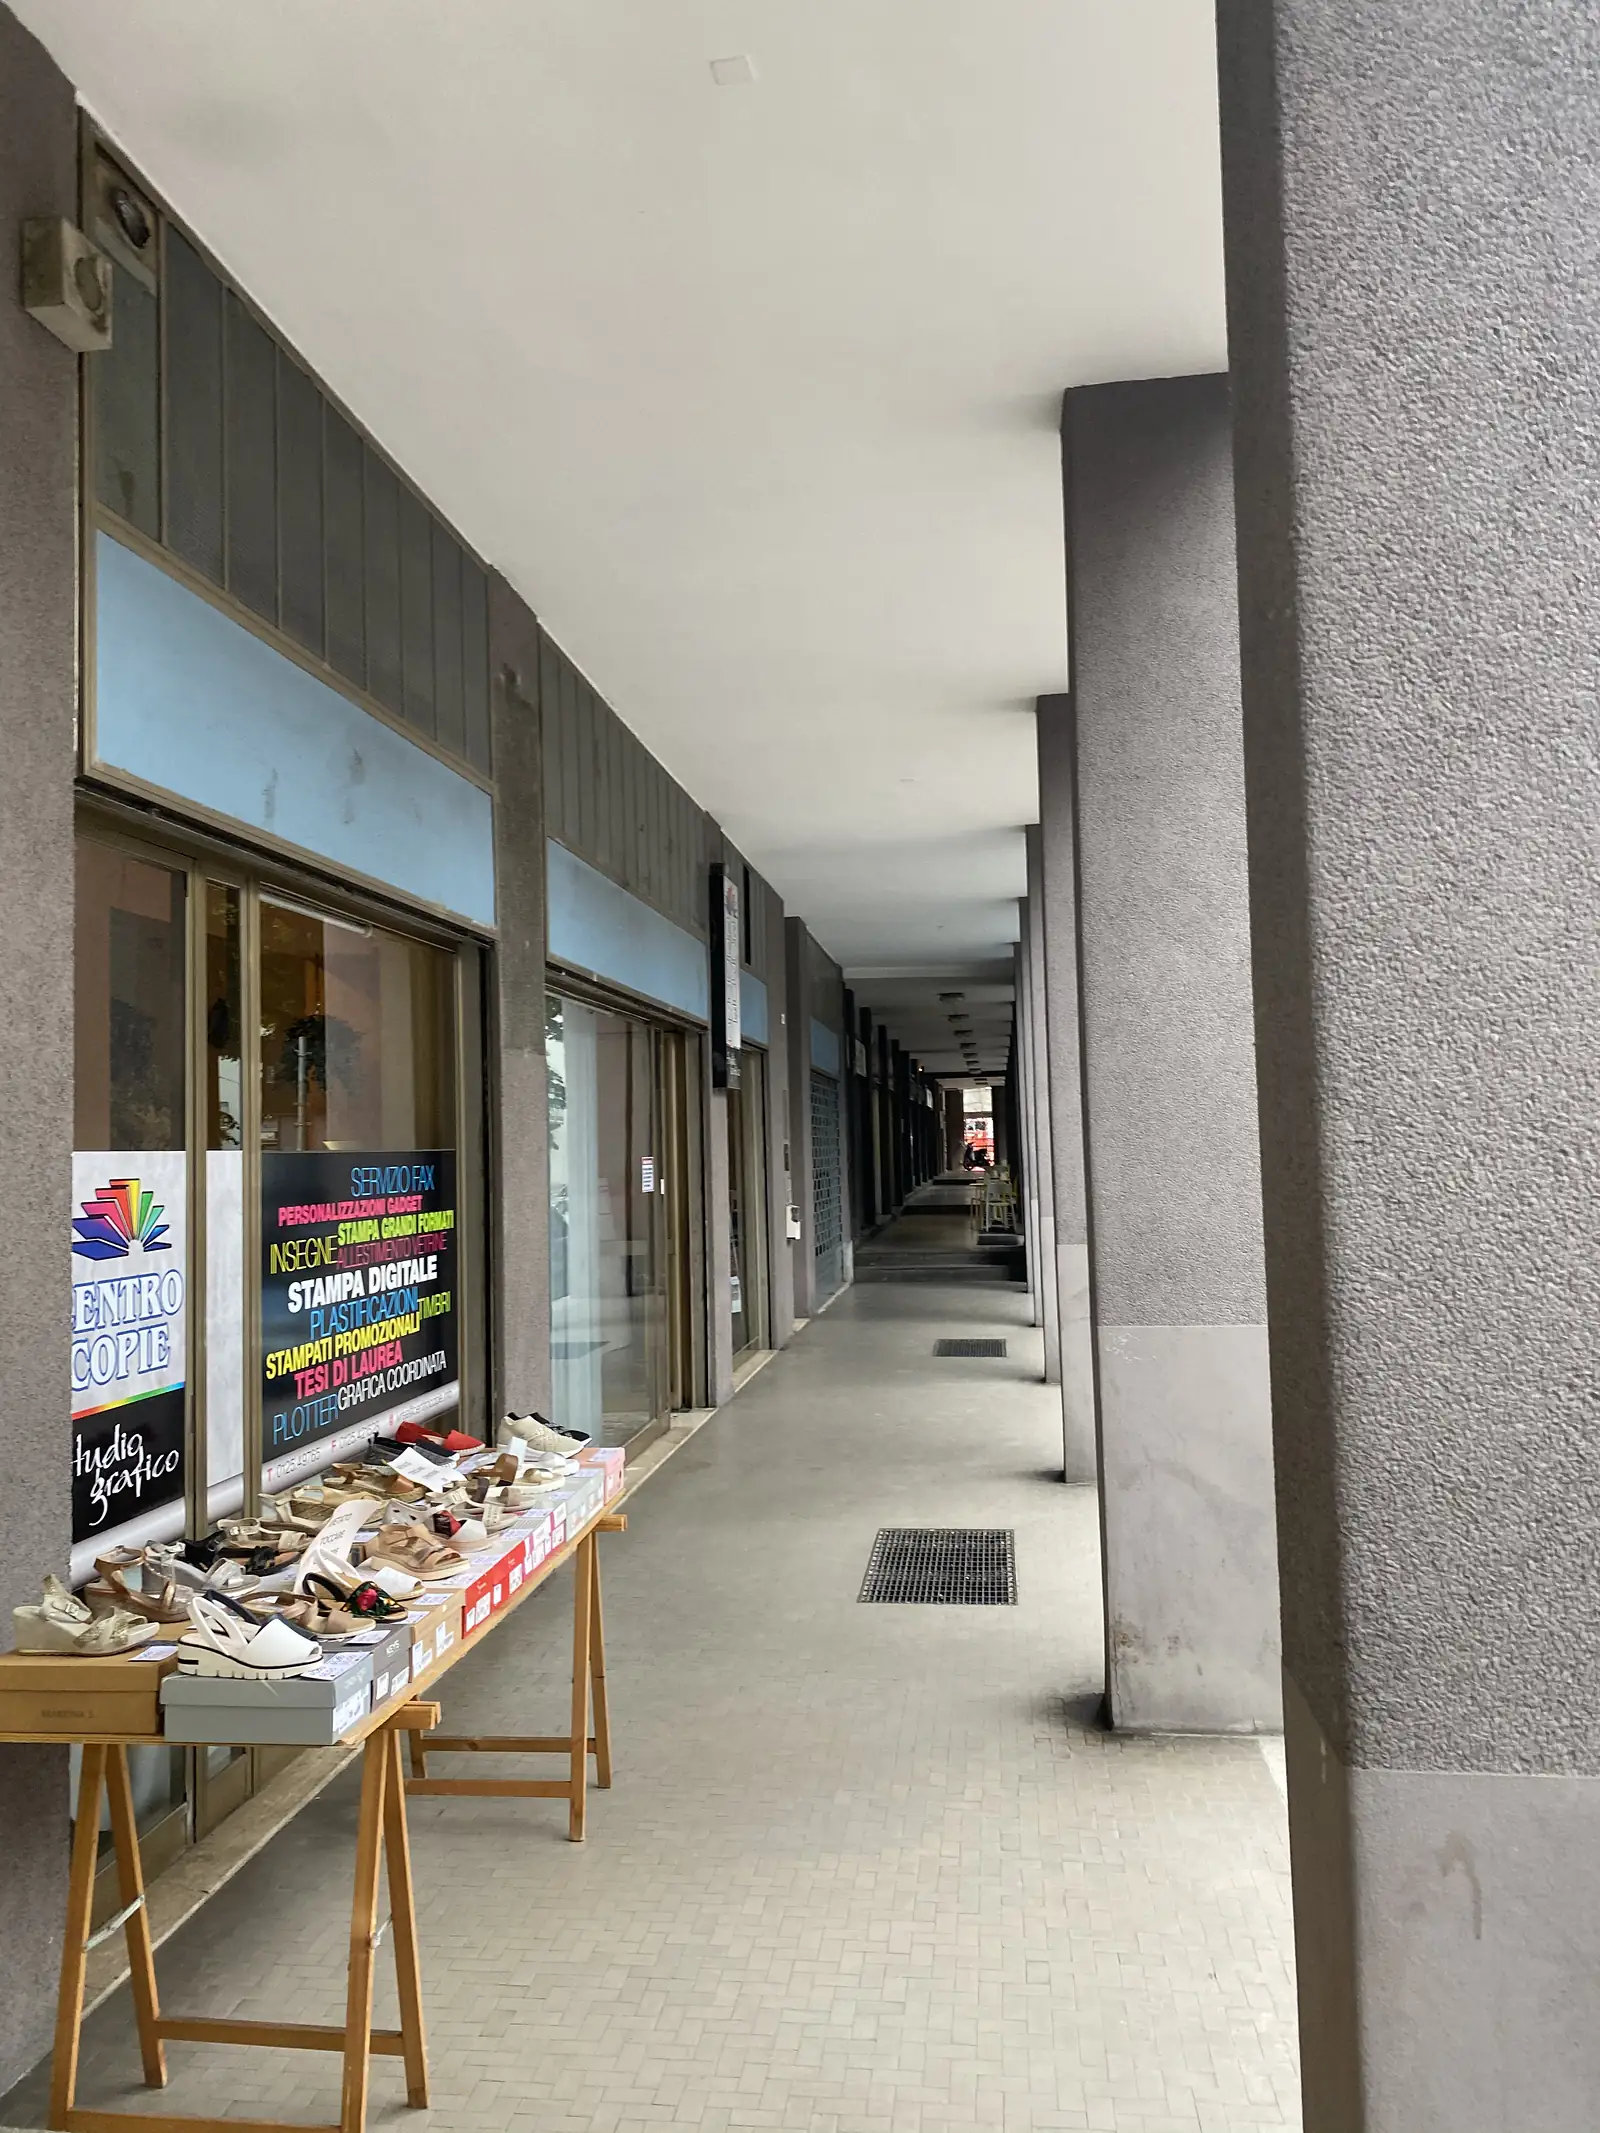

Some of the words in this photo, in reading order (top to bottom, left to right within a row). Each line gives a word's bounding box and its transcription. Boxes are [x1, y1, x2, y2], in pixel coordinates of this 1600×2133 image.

[351, 1165, 411, 1197] SERVIZIO
[412, 1165, 435, 1192] FAX
[278, 1198, 385, 1226] PERSONALIZZAZIONI
[387, 1195, 423, 1214] GADGET
[337, 1218, 380, 1246] STAMPA
[381, 1214, 417, 1240] GRANDI
[418, 1210, 454, 1234] FORMATI
[270, 1235, 338, 1274] INSEGNE
[336, 1237, 412, 1270] ALLESTIMENTO
[412, 1231, 448, 1255] VETRINE
[71, 1268, 184, 1334] ENTRO
[287, 1269, 366, 1314] STAMPA
[369, 1254, 438, 1295] DIGITALE
[416, 1290, 451, 1321] TIMBRI
[309, 1286, 419, 1341] PLASTIFICAZIONI
[71, 1322, 171, 1392] COPIE
[265, 1338, 333, 1380] STAMPATI
[334, 1312, 421, 1358] PROMOZIONALI
[293, 1365, 329, 1400] TESI
[332, 1354, 348, 1387] DI
[351, 1340, 403, 1383] LAUREA
[337, 1374, 386, 1412] GRAFICA
[386, 1350, 447, 1392] COORDINATA
[273, 1393, 339, 1446] PLOTTER
[70, 1423, 143, 1477] tudio
[89, 1445, 180, 1526] grafico
